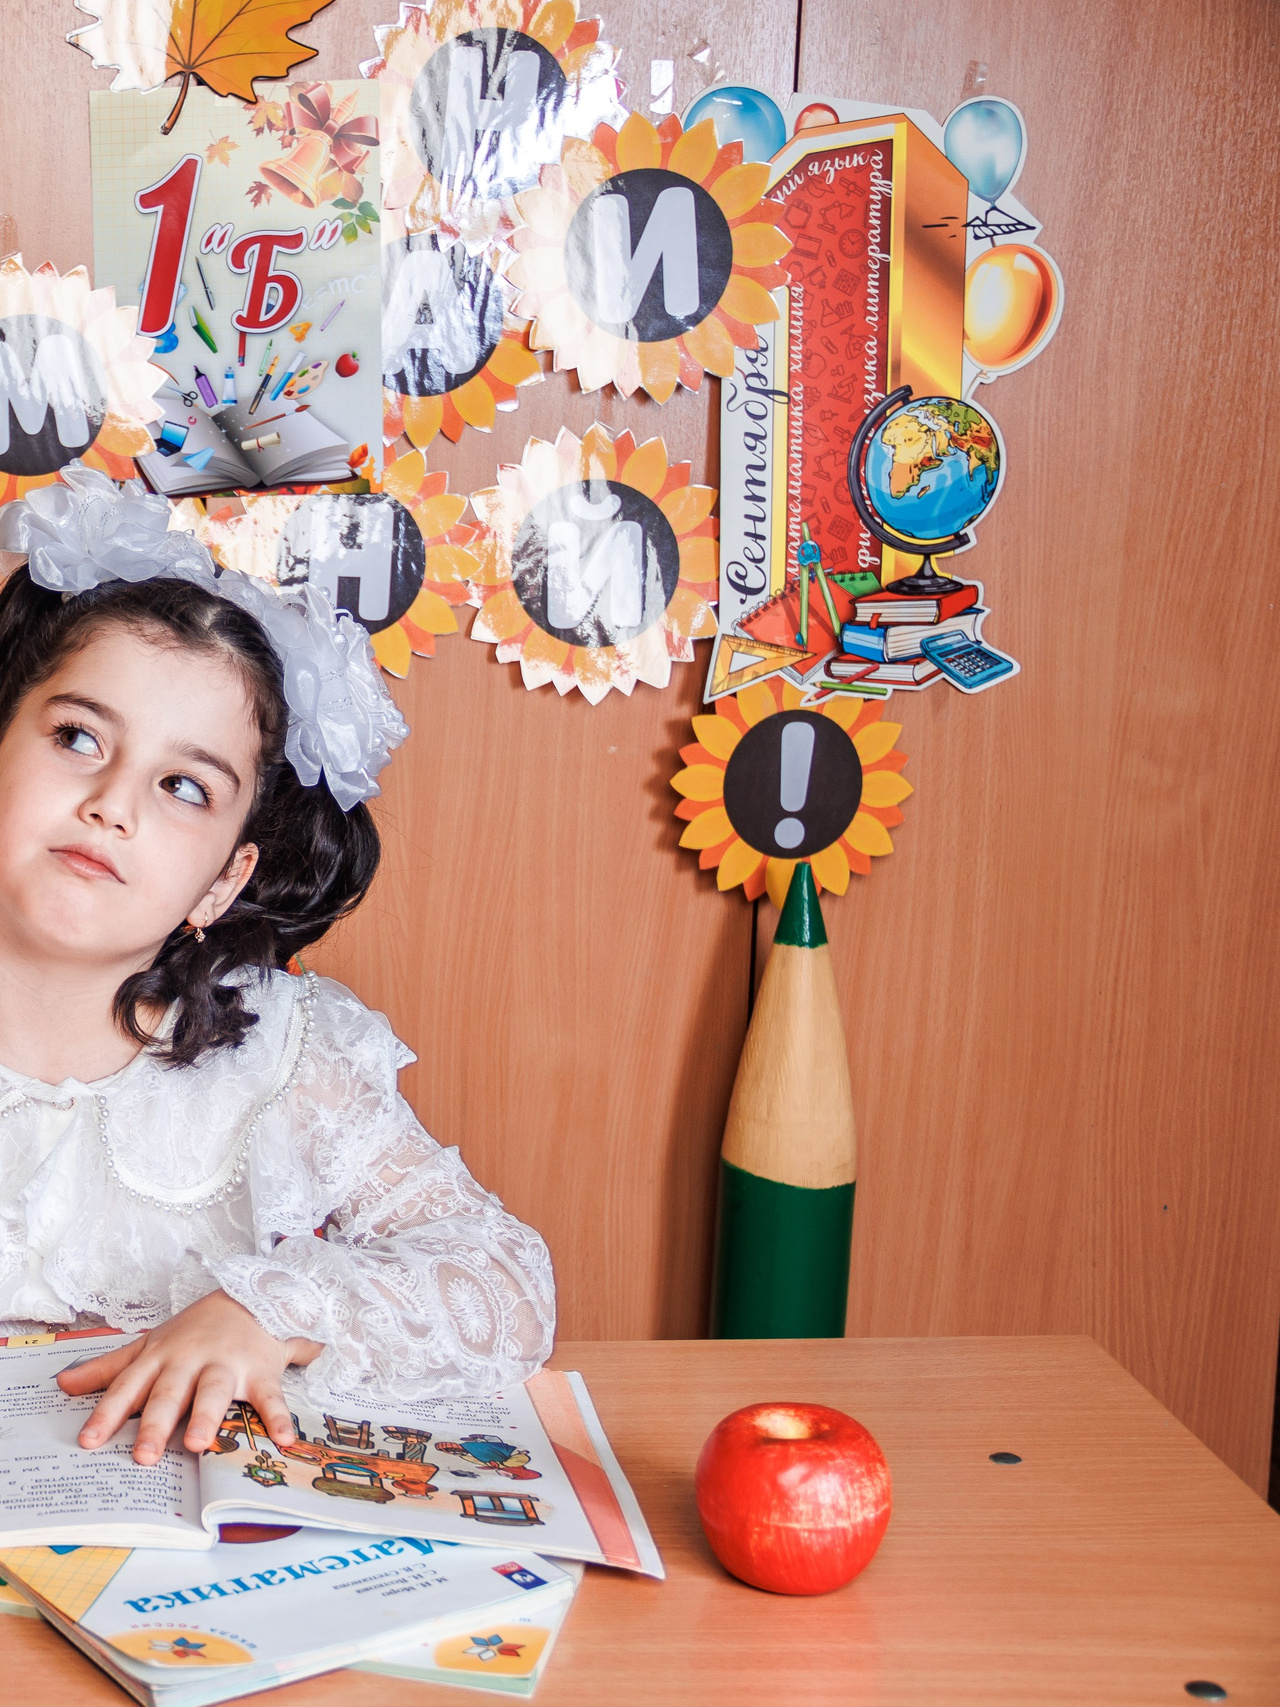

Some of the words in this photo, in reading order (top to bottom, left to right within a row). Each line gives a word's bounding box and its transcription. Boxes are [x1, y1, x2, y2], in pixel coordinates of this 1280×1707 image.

[808, 151, 870, 185] язык
[135, 154, 203, 338] 1
[589, 186, 700, 324] И
[864, 149, 892, 331] литература
[381, 250, 478, 375] А
[788, 280, 804, 374] химия
[726, 335, 790, 605] Сентября
[786, 380, 804, 577] математика
[309, 499, 395, 621] Н
[547, 493, 643, 630] Й
[774, 721, 815, 849] !
[123, 1536, 460, 1613] Математика
